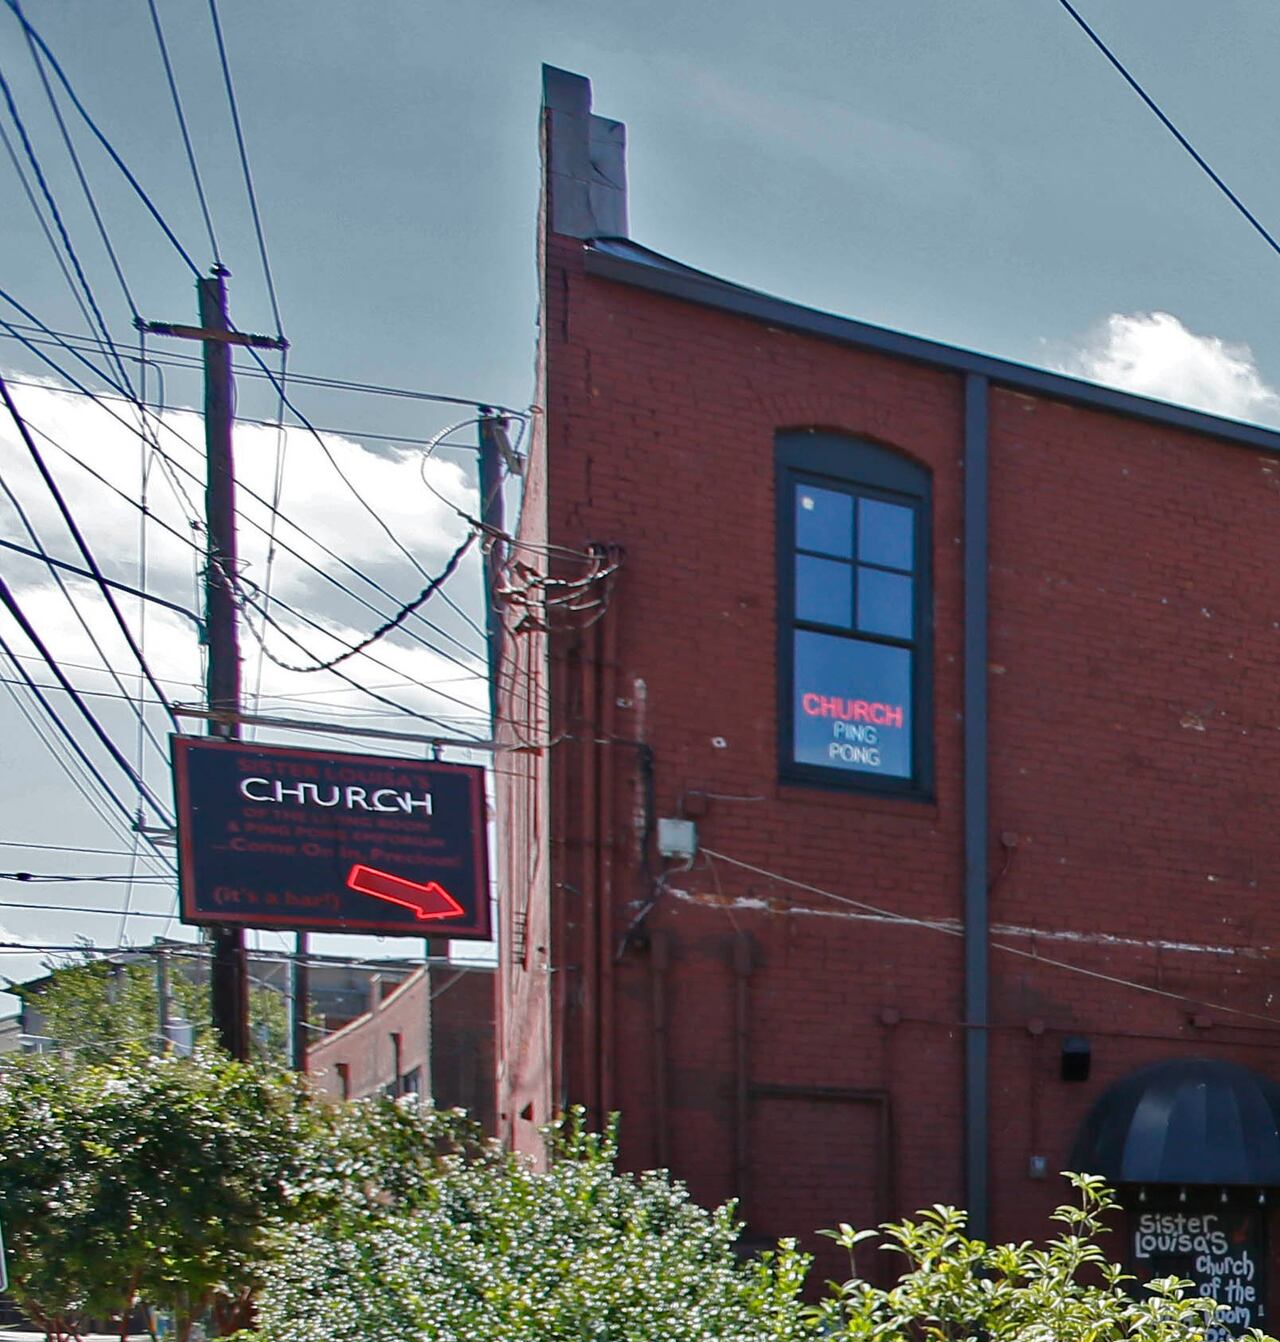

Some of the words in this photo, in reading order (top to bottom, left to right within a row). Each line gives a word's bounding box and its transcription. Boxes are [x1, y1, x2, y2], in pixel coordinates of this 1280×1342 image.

[802, 693, 903, 728] CHURCH
[833, 721, 878, 744] PING
[829, 742, 880, 766] PONG
[240, 777, 433, 815] CHURCH
[1140, 1213, 1218, 1235] Sister
[1200, 1277, 1221, 1299] of
[1224, 1278, 1256, 1305] the
